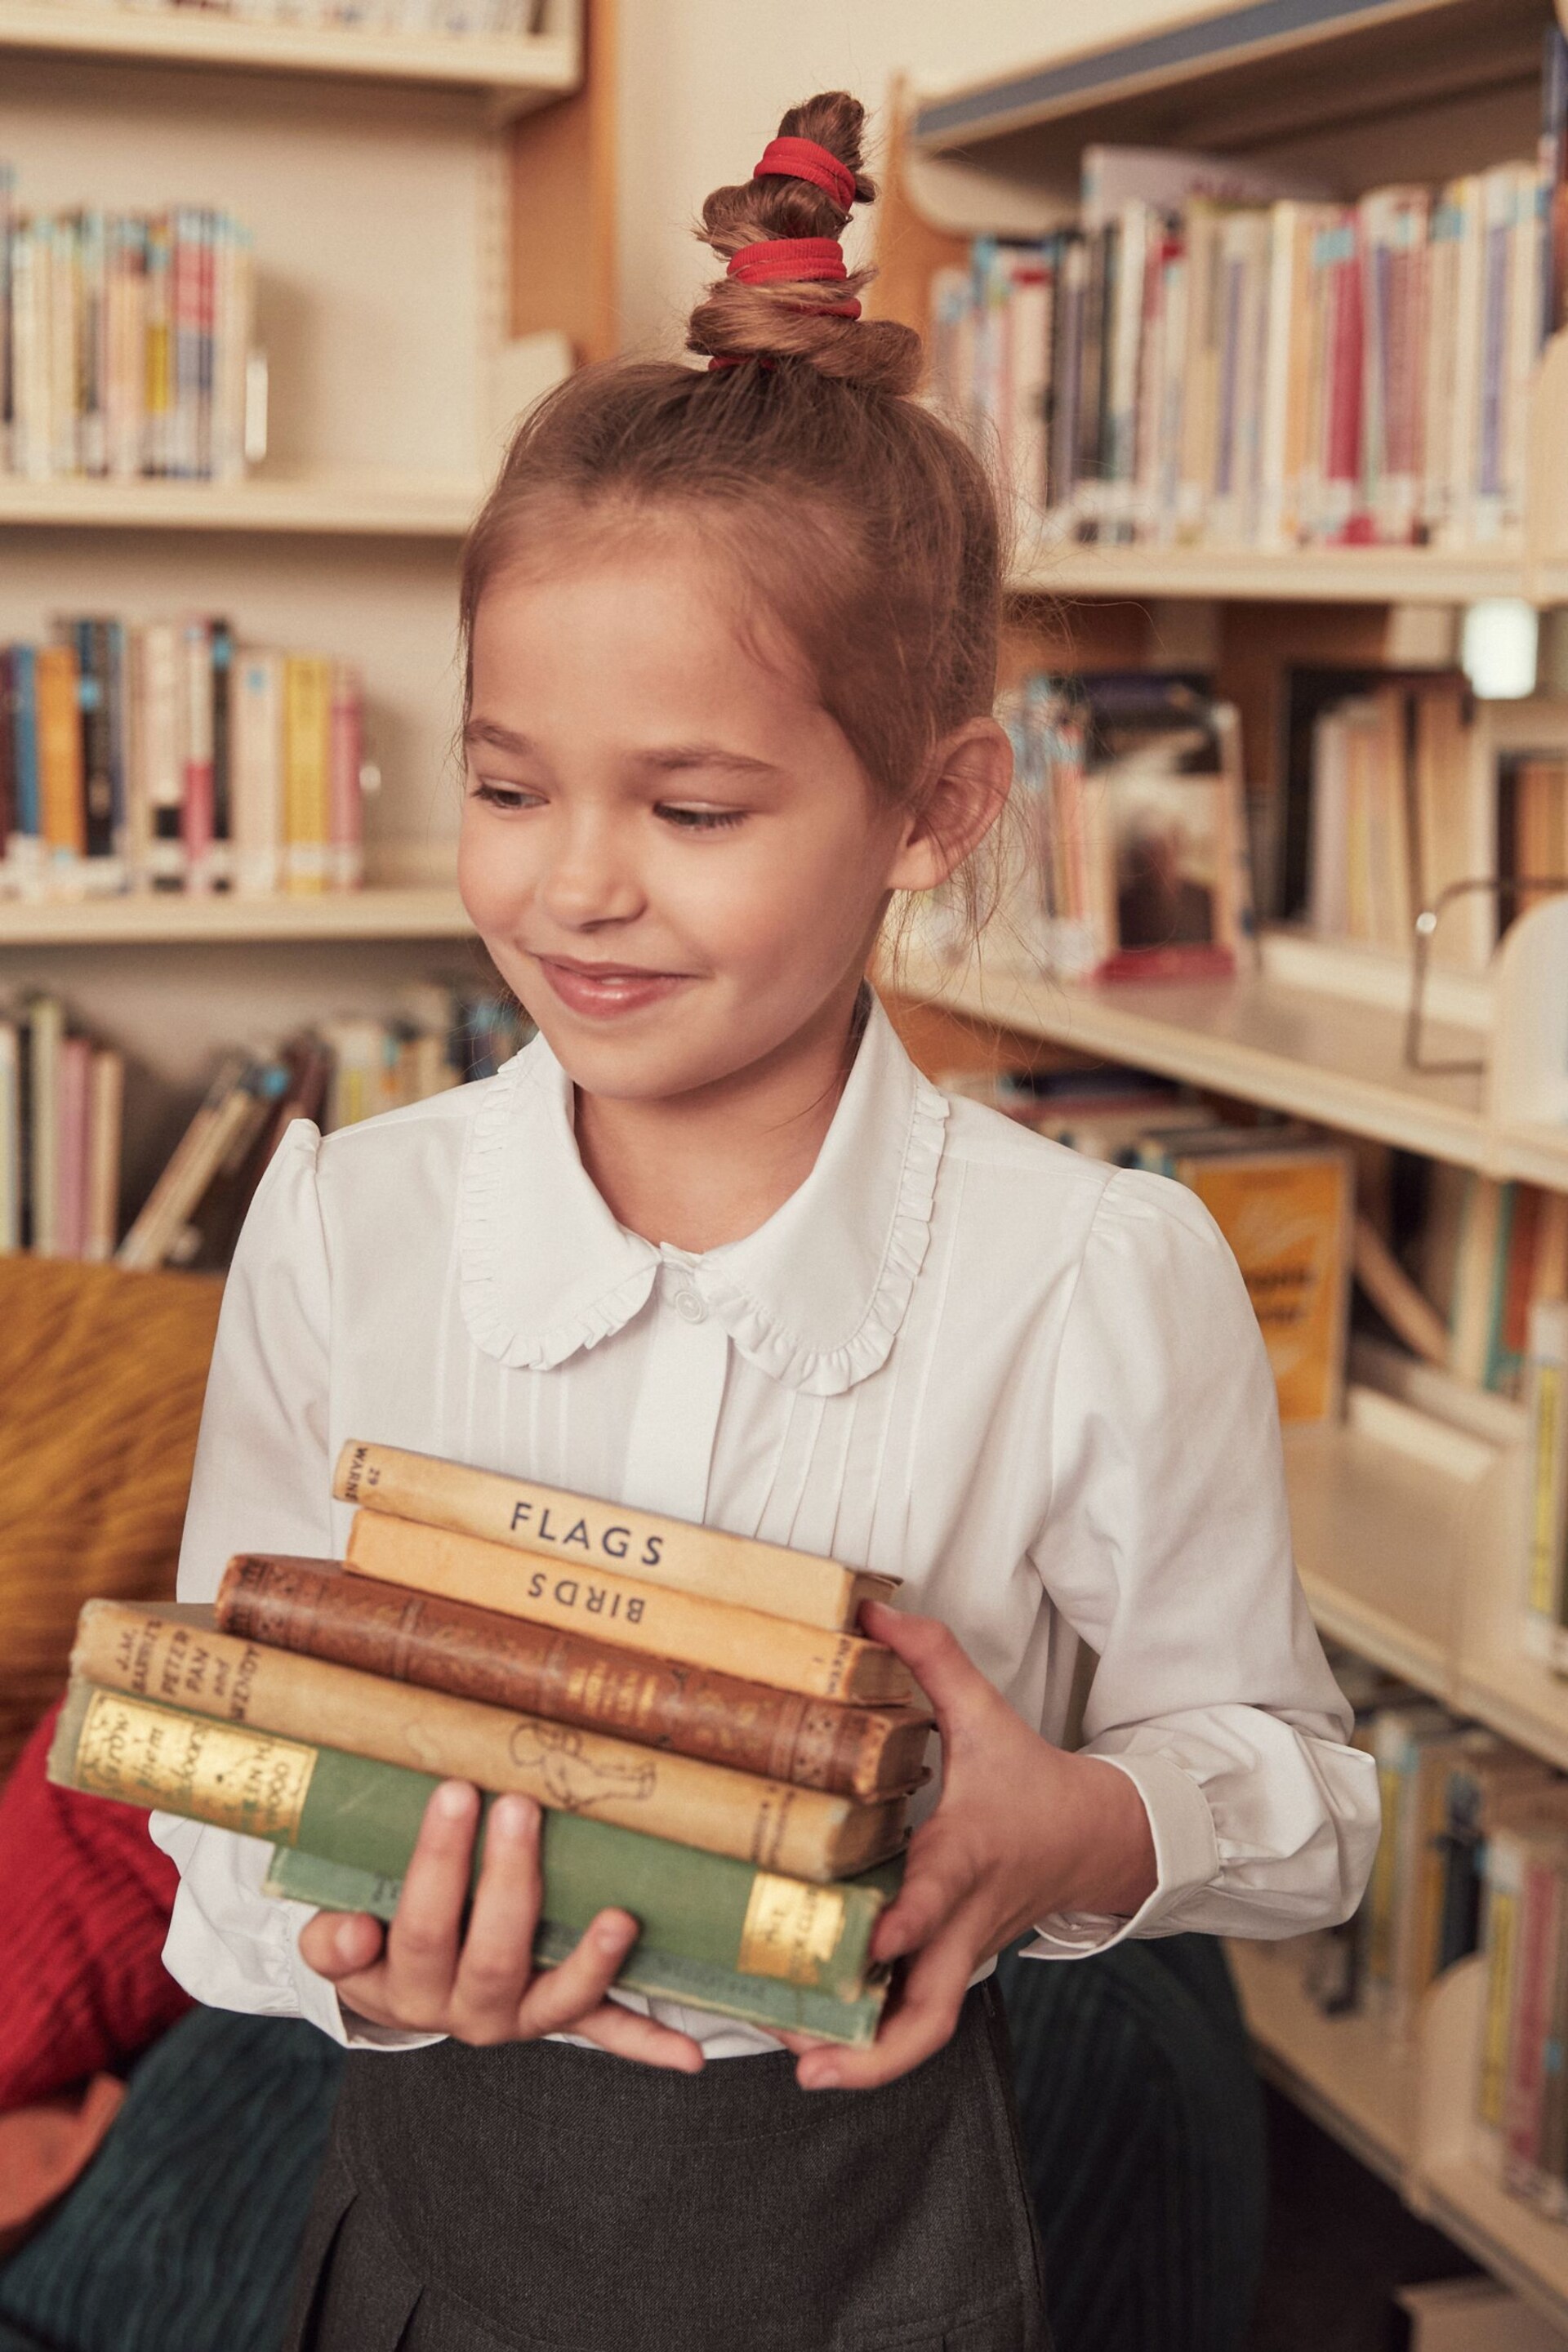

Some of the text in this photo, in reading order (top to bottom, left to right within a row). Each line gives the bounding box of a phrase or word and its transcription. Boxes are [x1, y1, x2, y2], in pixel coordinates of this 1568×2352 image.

[510, 1500, 664, 1566] FLAGS
[528, 1573, 646, 1624] BIRDS
[161, 1631, 189, 1696] PETER
[185, 1647, 209, 1694] PAN
[231, 1645, 259, 1720] WENDY
